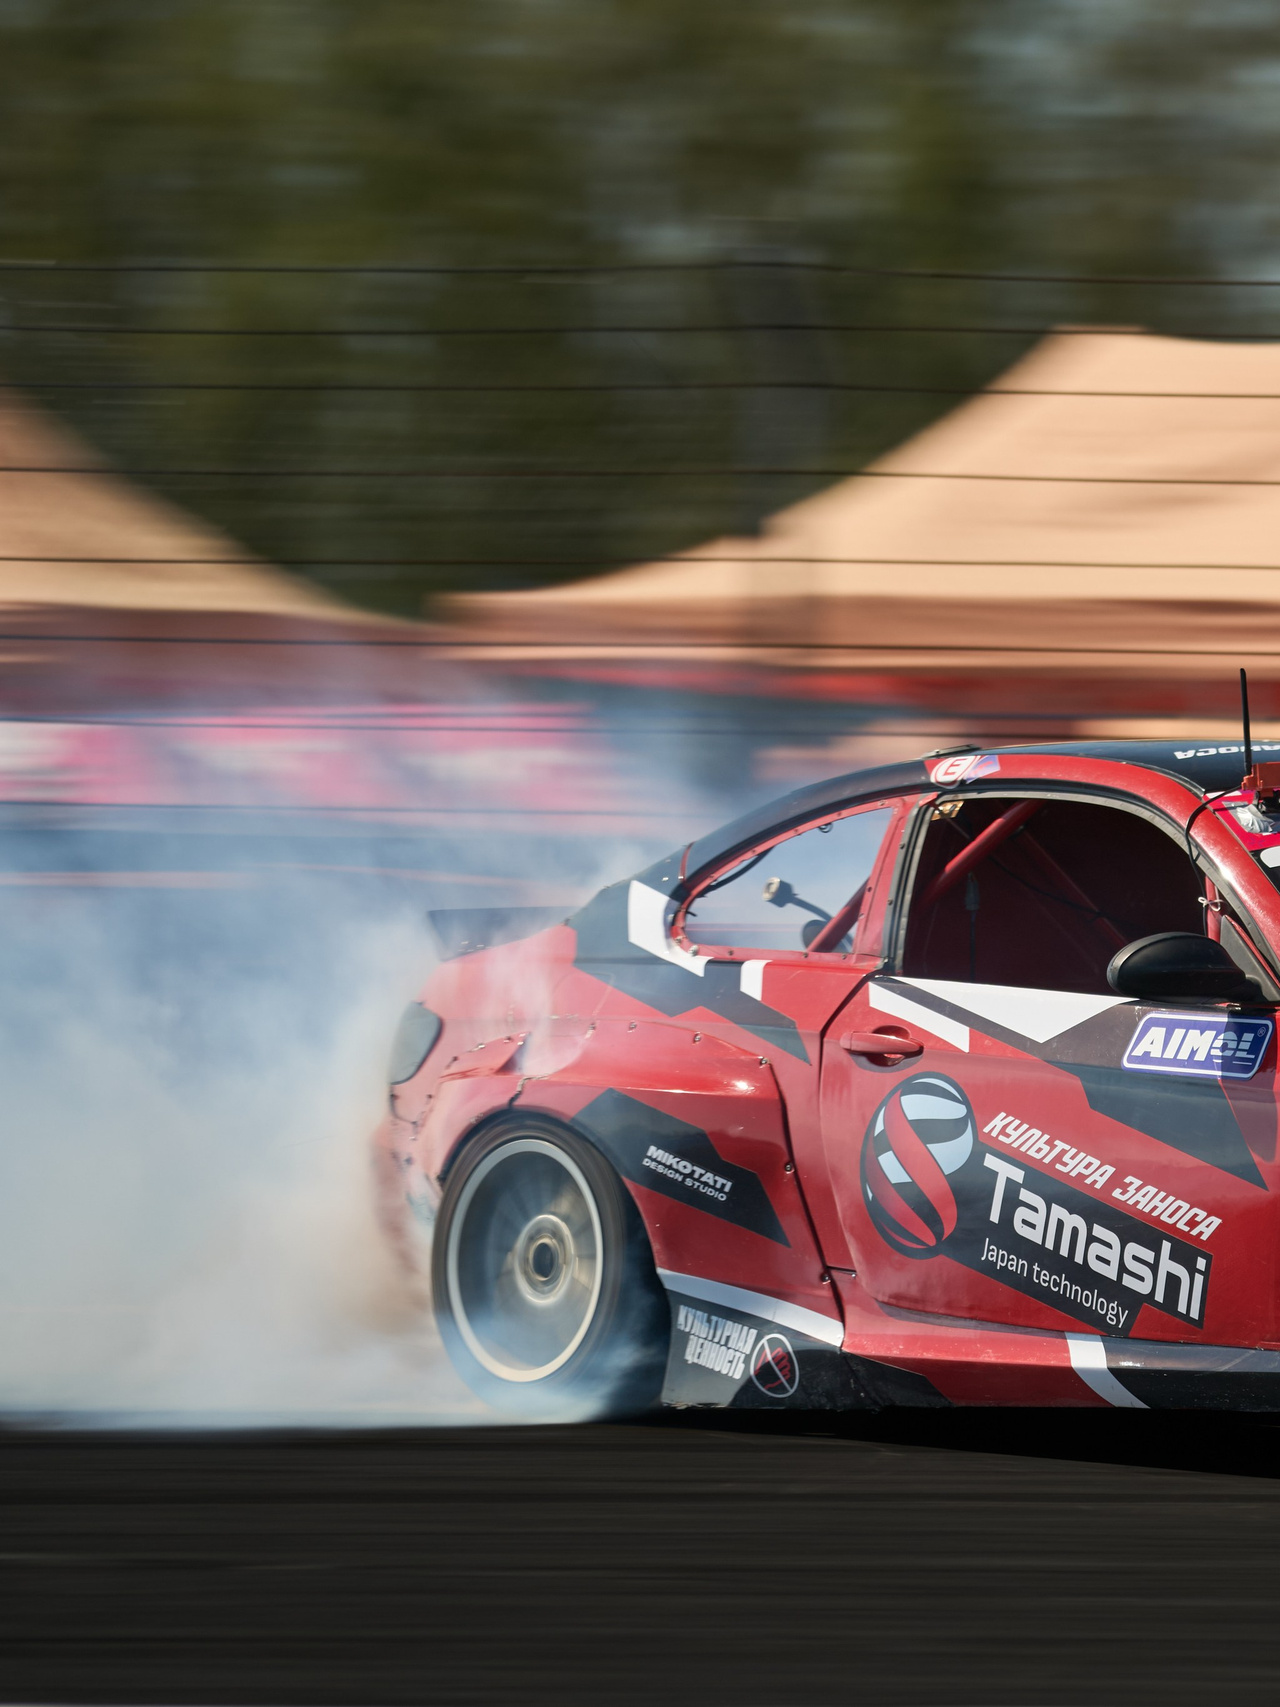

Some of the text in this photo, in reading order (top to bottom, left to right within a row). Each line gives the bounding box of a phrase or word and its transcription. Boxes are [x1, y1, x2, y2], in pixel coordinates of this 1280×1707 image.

[1131, 1026, 1256, 1065] AIMOL
[642, 1157, 727, 1201] DESIGN STUDIO
[646, 1145, 733, 1193] MIKOTATI
[982, 1111, 1223, 1242] КУЛЬТУРА ЗАНОСА
[983, 1152, 1207, 1321] Tamashi
[981, 1237, 1129, 1329] Japan technology
[676, 1304, 758, 1355] КУЛЬТУРНАЯ
[684, 1334, 746, 1380] ЦЕННОСТЬ
